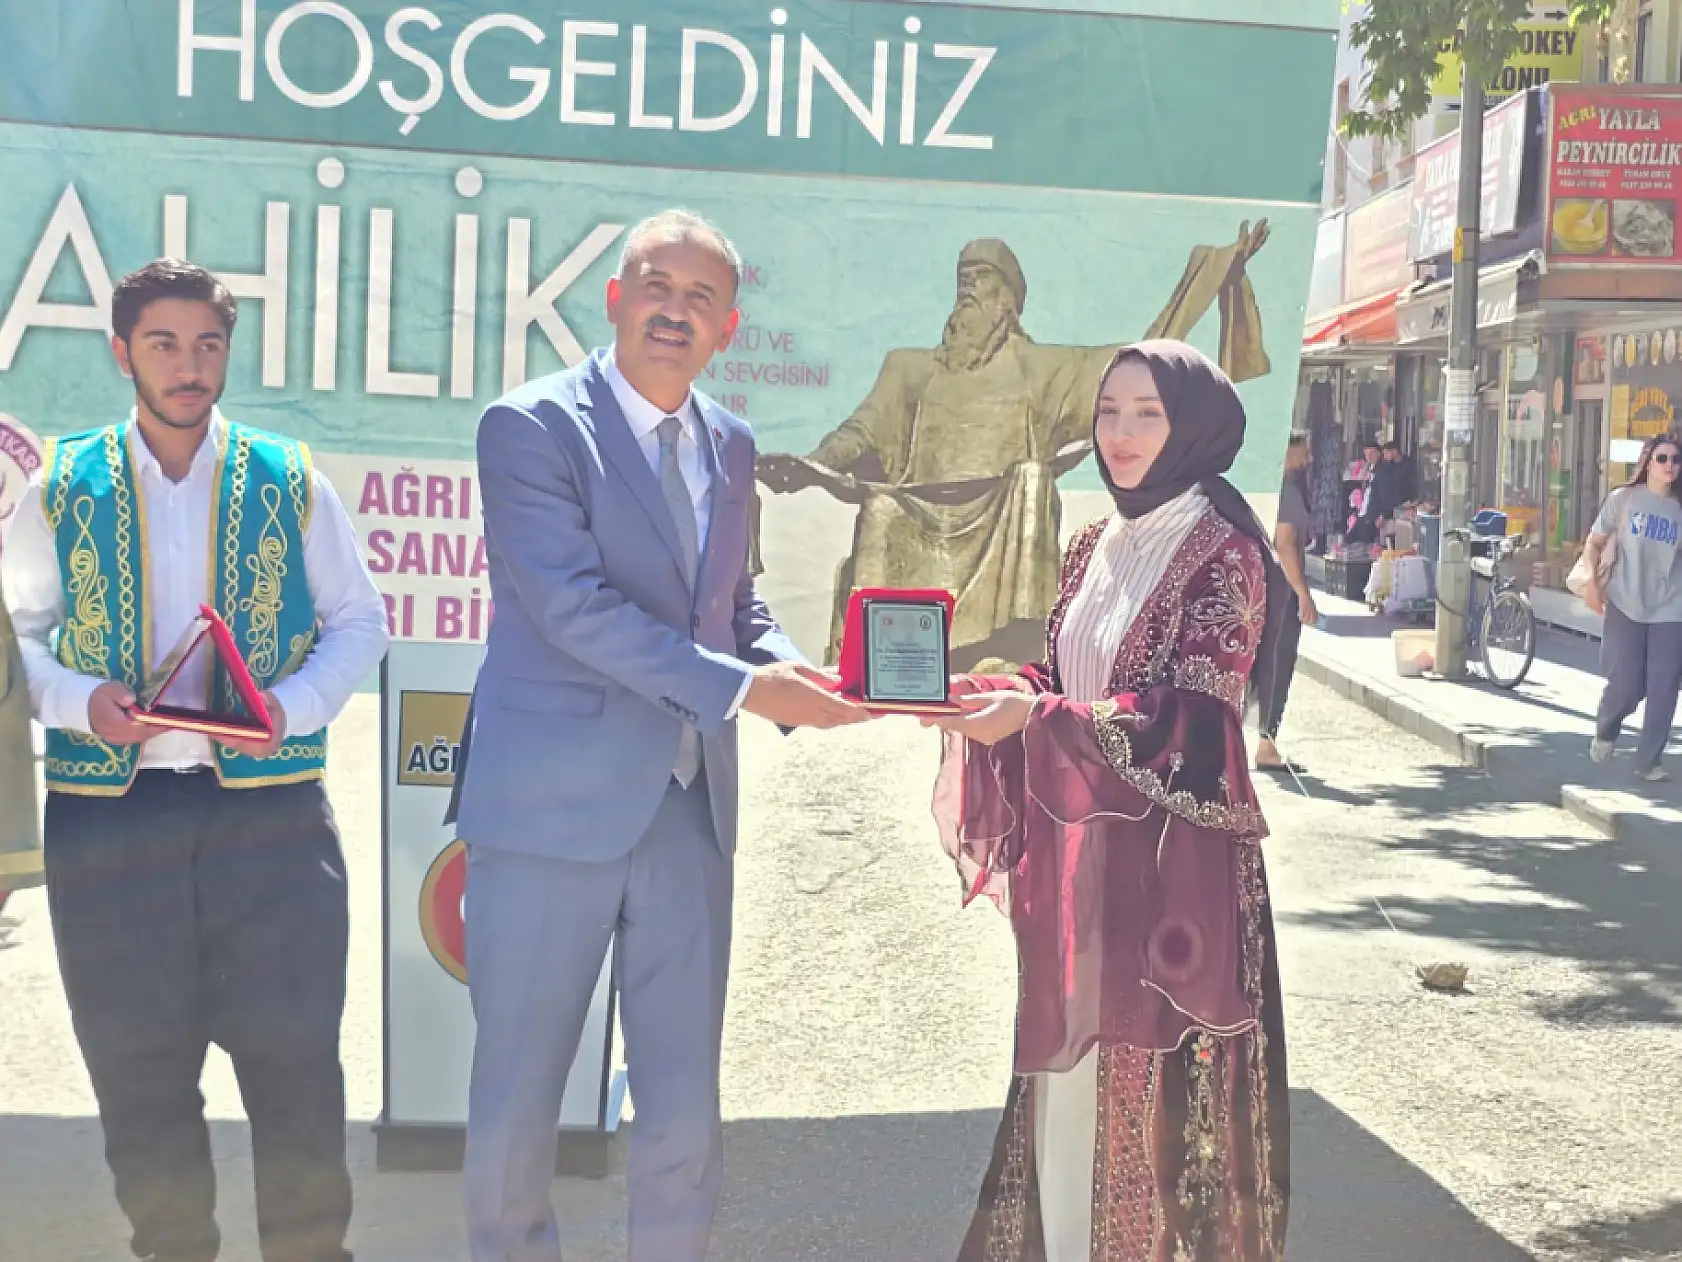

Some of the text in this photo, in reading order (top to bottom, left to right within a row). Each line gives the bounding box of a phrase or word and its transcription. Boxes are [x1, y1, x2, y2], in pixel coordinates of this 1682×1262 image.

[177, 0, 998, 150] HOŞGELDİNİZ
[0, 157, 626, 399] AHİLİK
[767, 331, 795, 353] VE
[724, 361, 829, 387] SEVGİSİNİ
[357, 465, 472, 520] AĞRI
[367, 529, 489, 578] SANA
[1645, 514, 1678, 545] NBA
